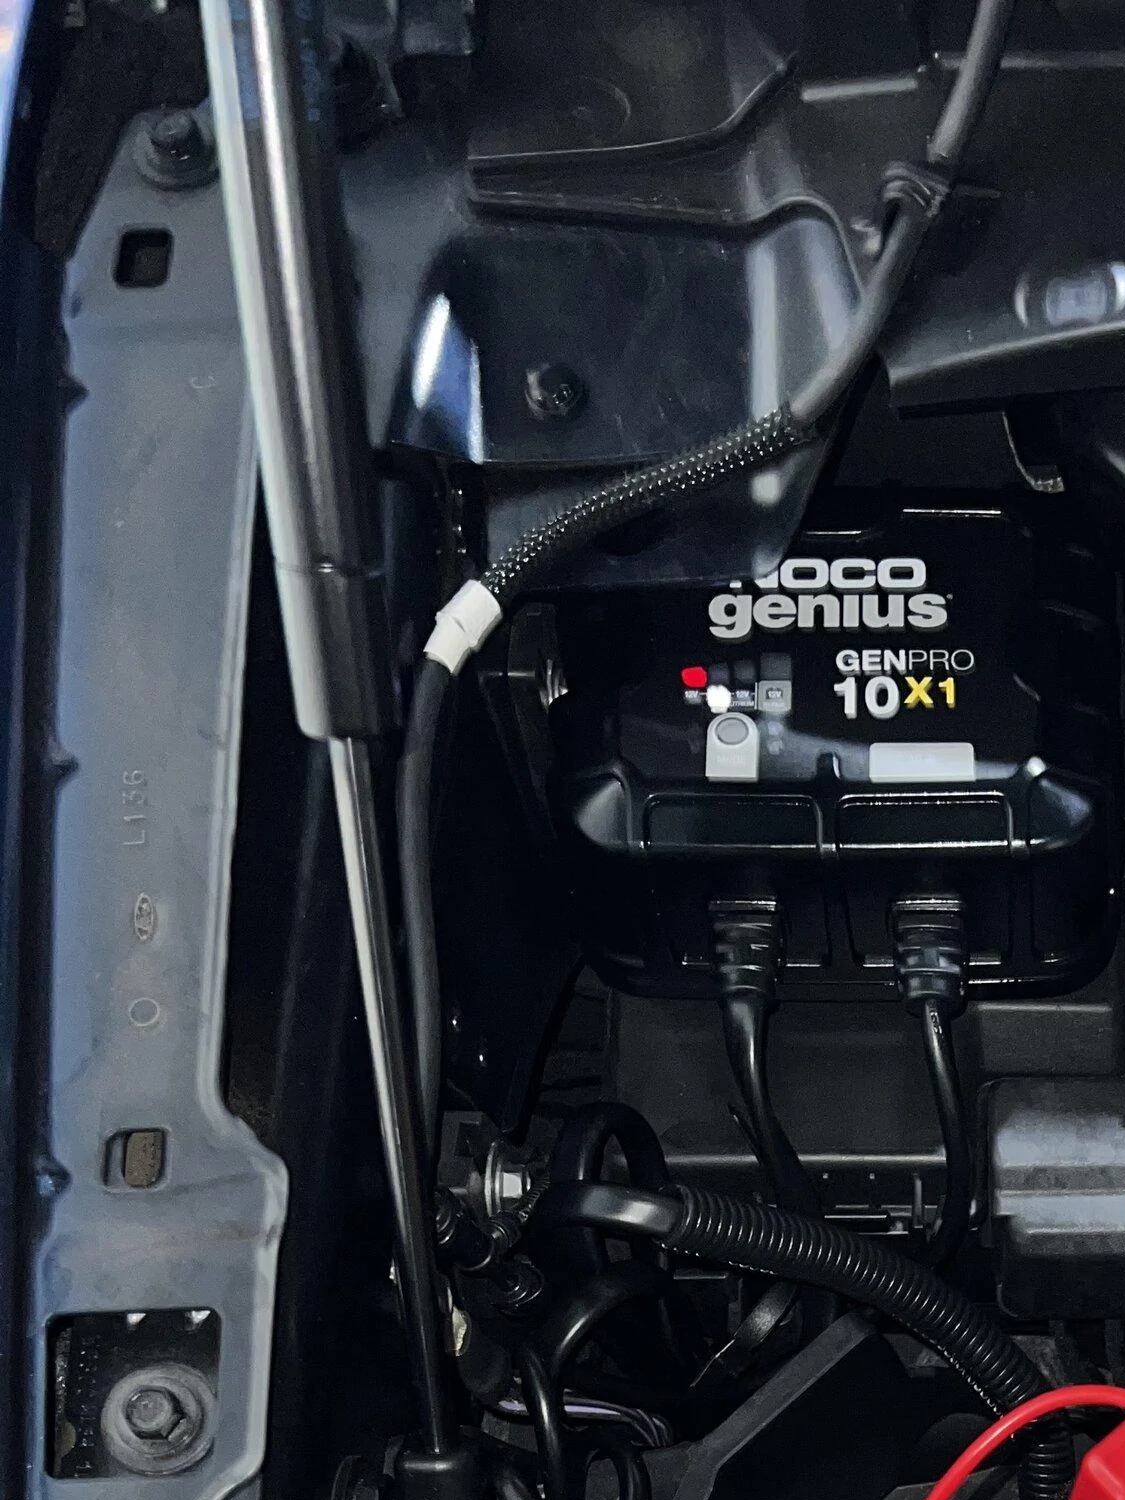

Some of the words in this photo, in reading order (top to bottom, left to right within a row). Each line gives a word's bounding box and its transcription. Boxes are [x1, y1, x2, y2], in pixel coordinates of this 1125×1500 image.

[728, 557, 928, 590] OCO
[708, 593, 948, 640] genius
[835, 649, 976, 674] GENPRO
